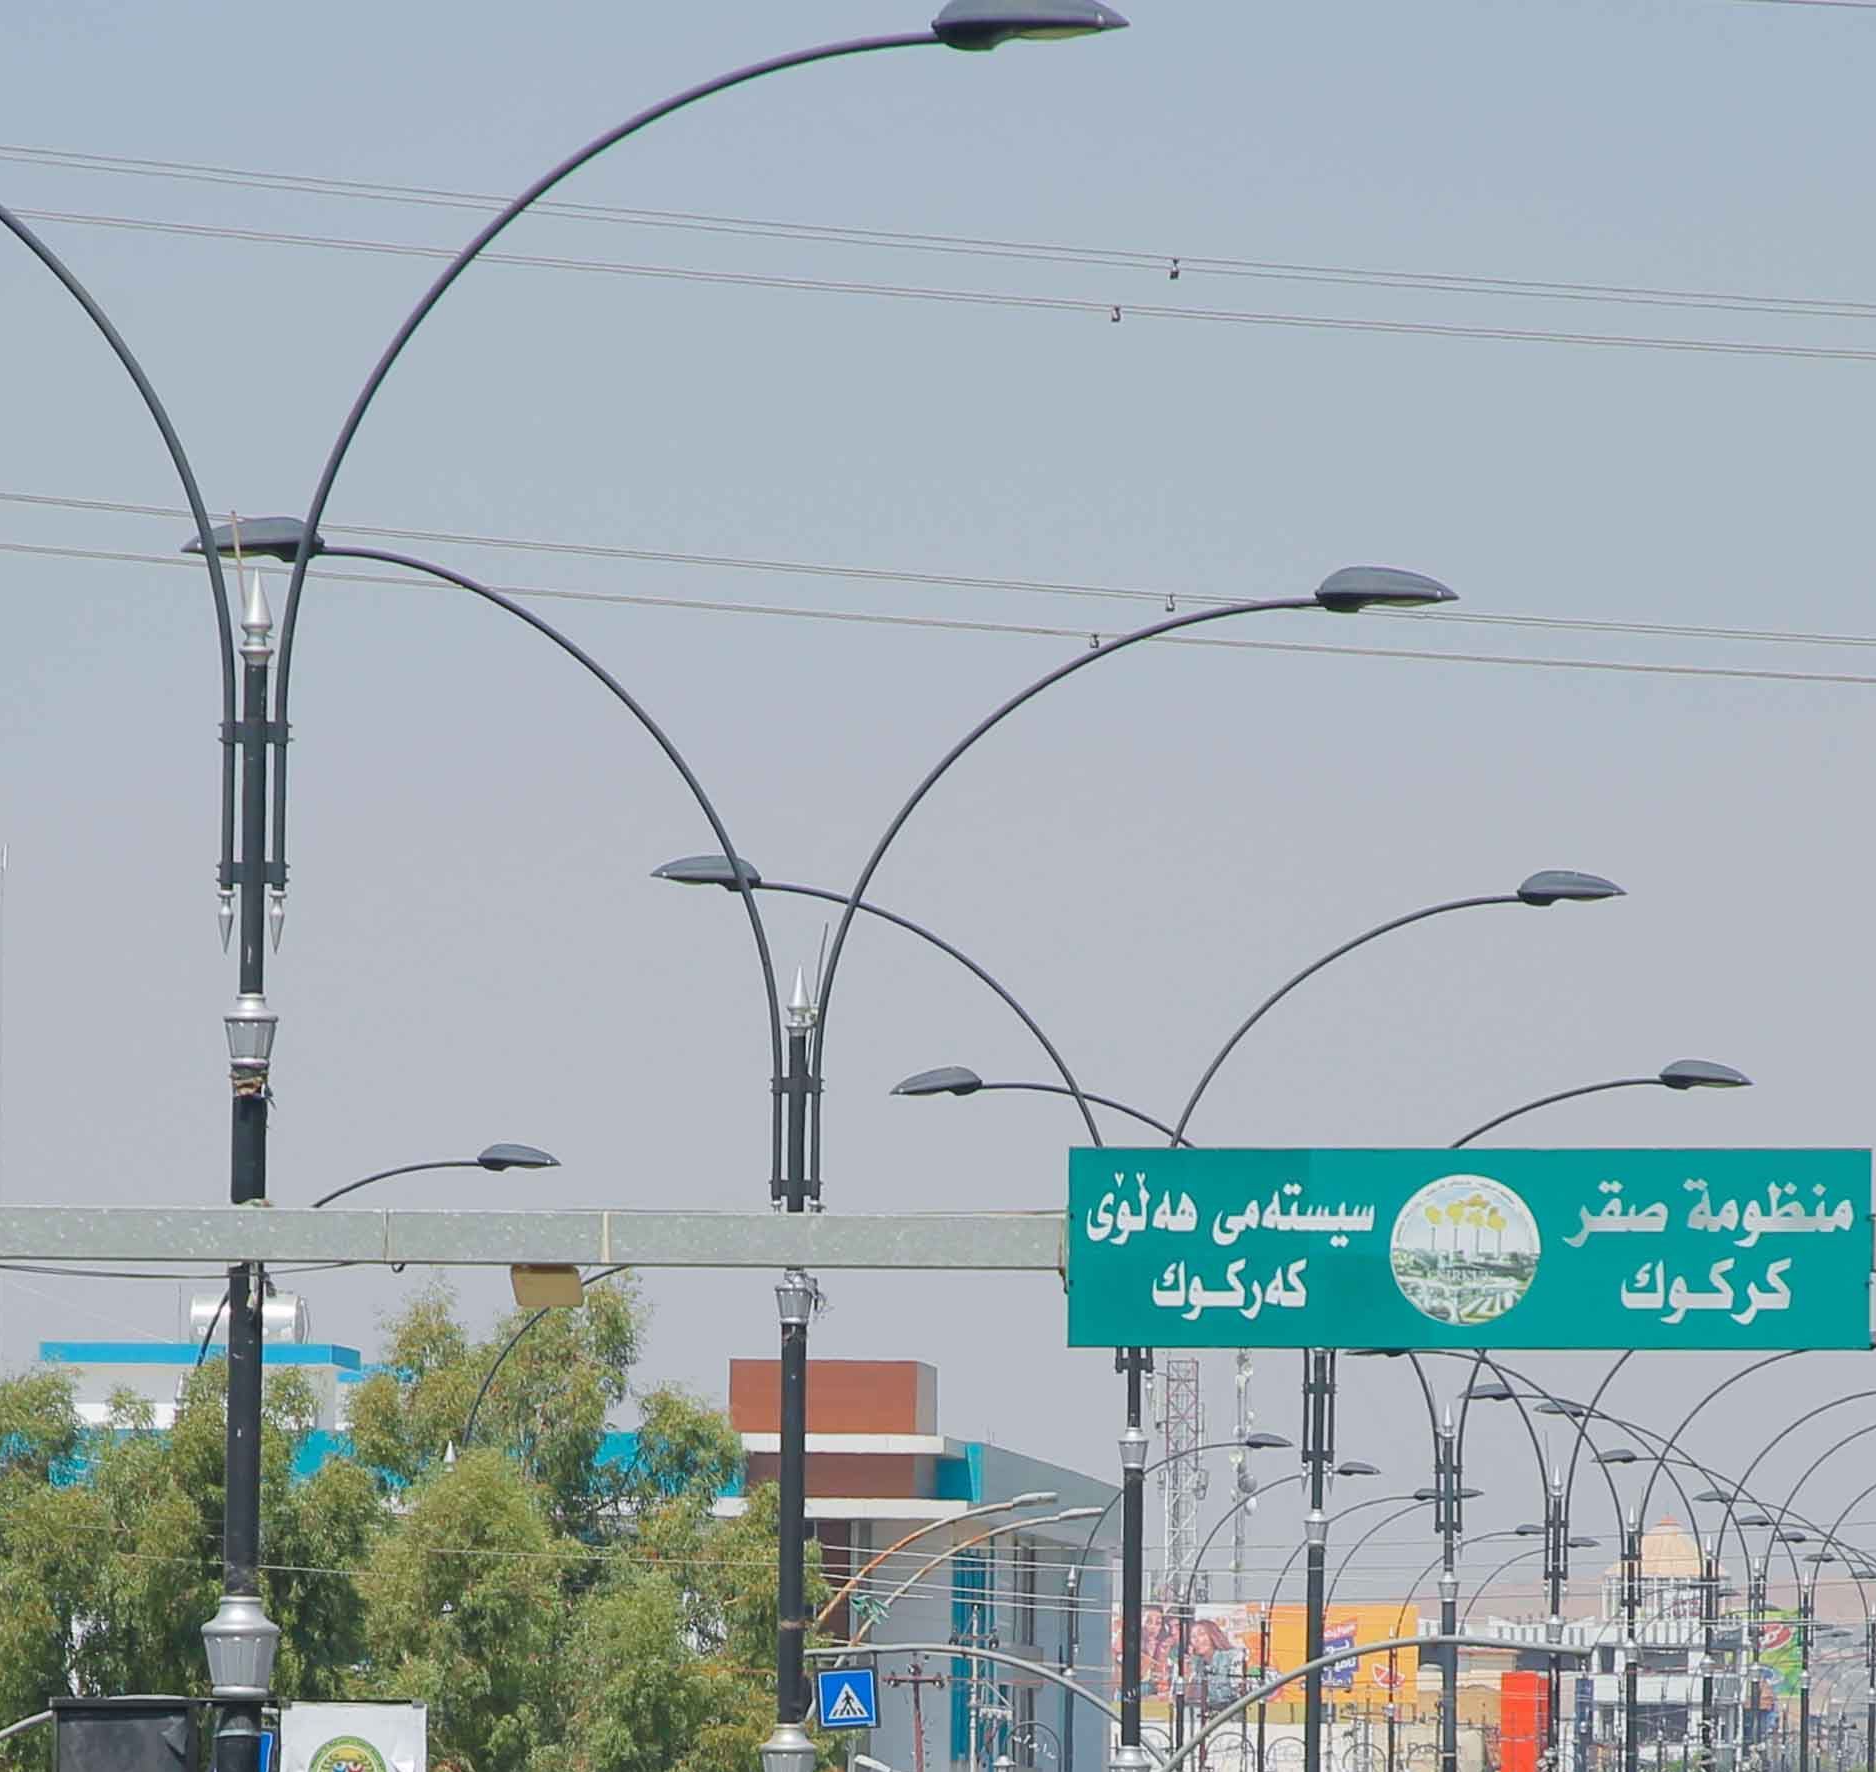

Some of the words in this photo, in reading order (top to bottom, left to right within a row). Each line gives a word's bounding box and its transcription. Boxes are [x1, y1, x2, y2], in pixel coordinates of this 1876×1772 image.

[1562, 1178, 1667, 1247] صقر
[1688, 1177, 1854, 1246] منظومة
[1621, 1258, 1792, 1325] كركوك
